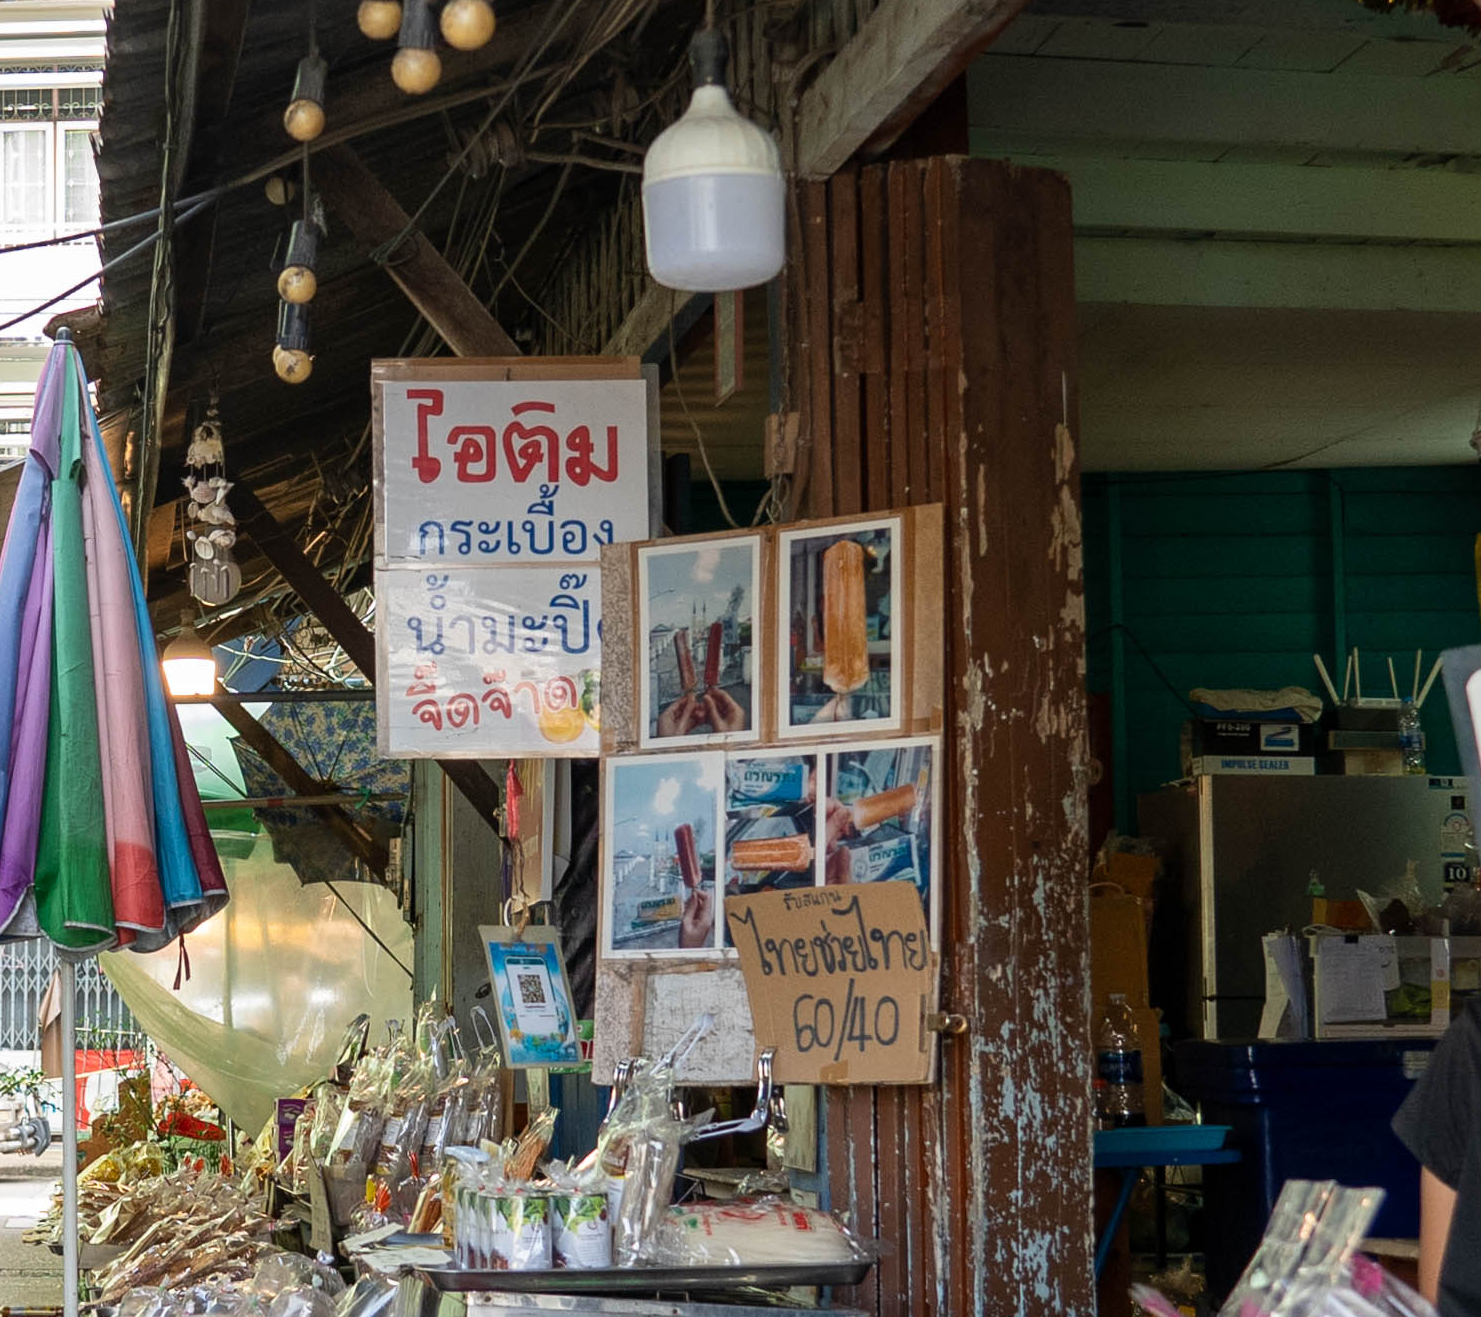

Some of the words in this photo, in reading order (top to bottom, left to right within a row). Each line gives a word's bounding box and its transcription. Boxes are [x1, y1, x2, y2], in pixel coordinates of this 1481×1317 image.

[406, 389, 619, 486] ไอติม
[417, 484, 615, 556] กระเบื้อง
[729, 894, 928, 977] ไทยช่วยไทย
[793, 978, 900, 1062] 60/40
